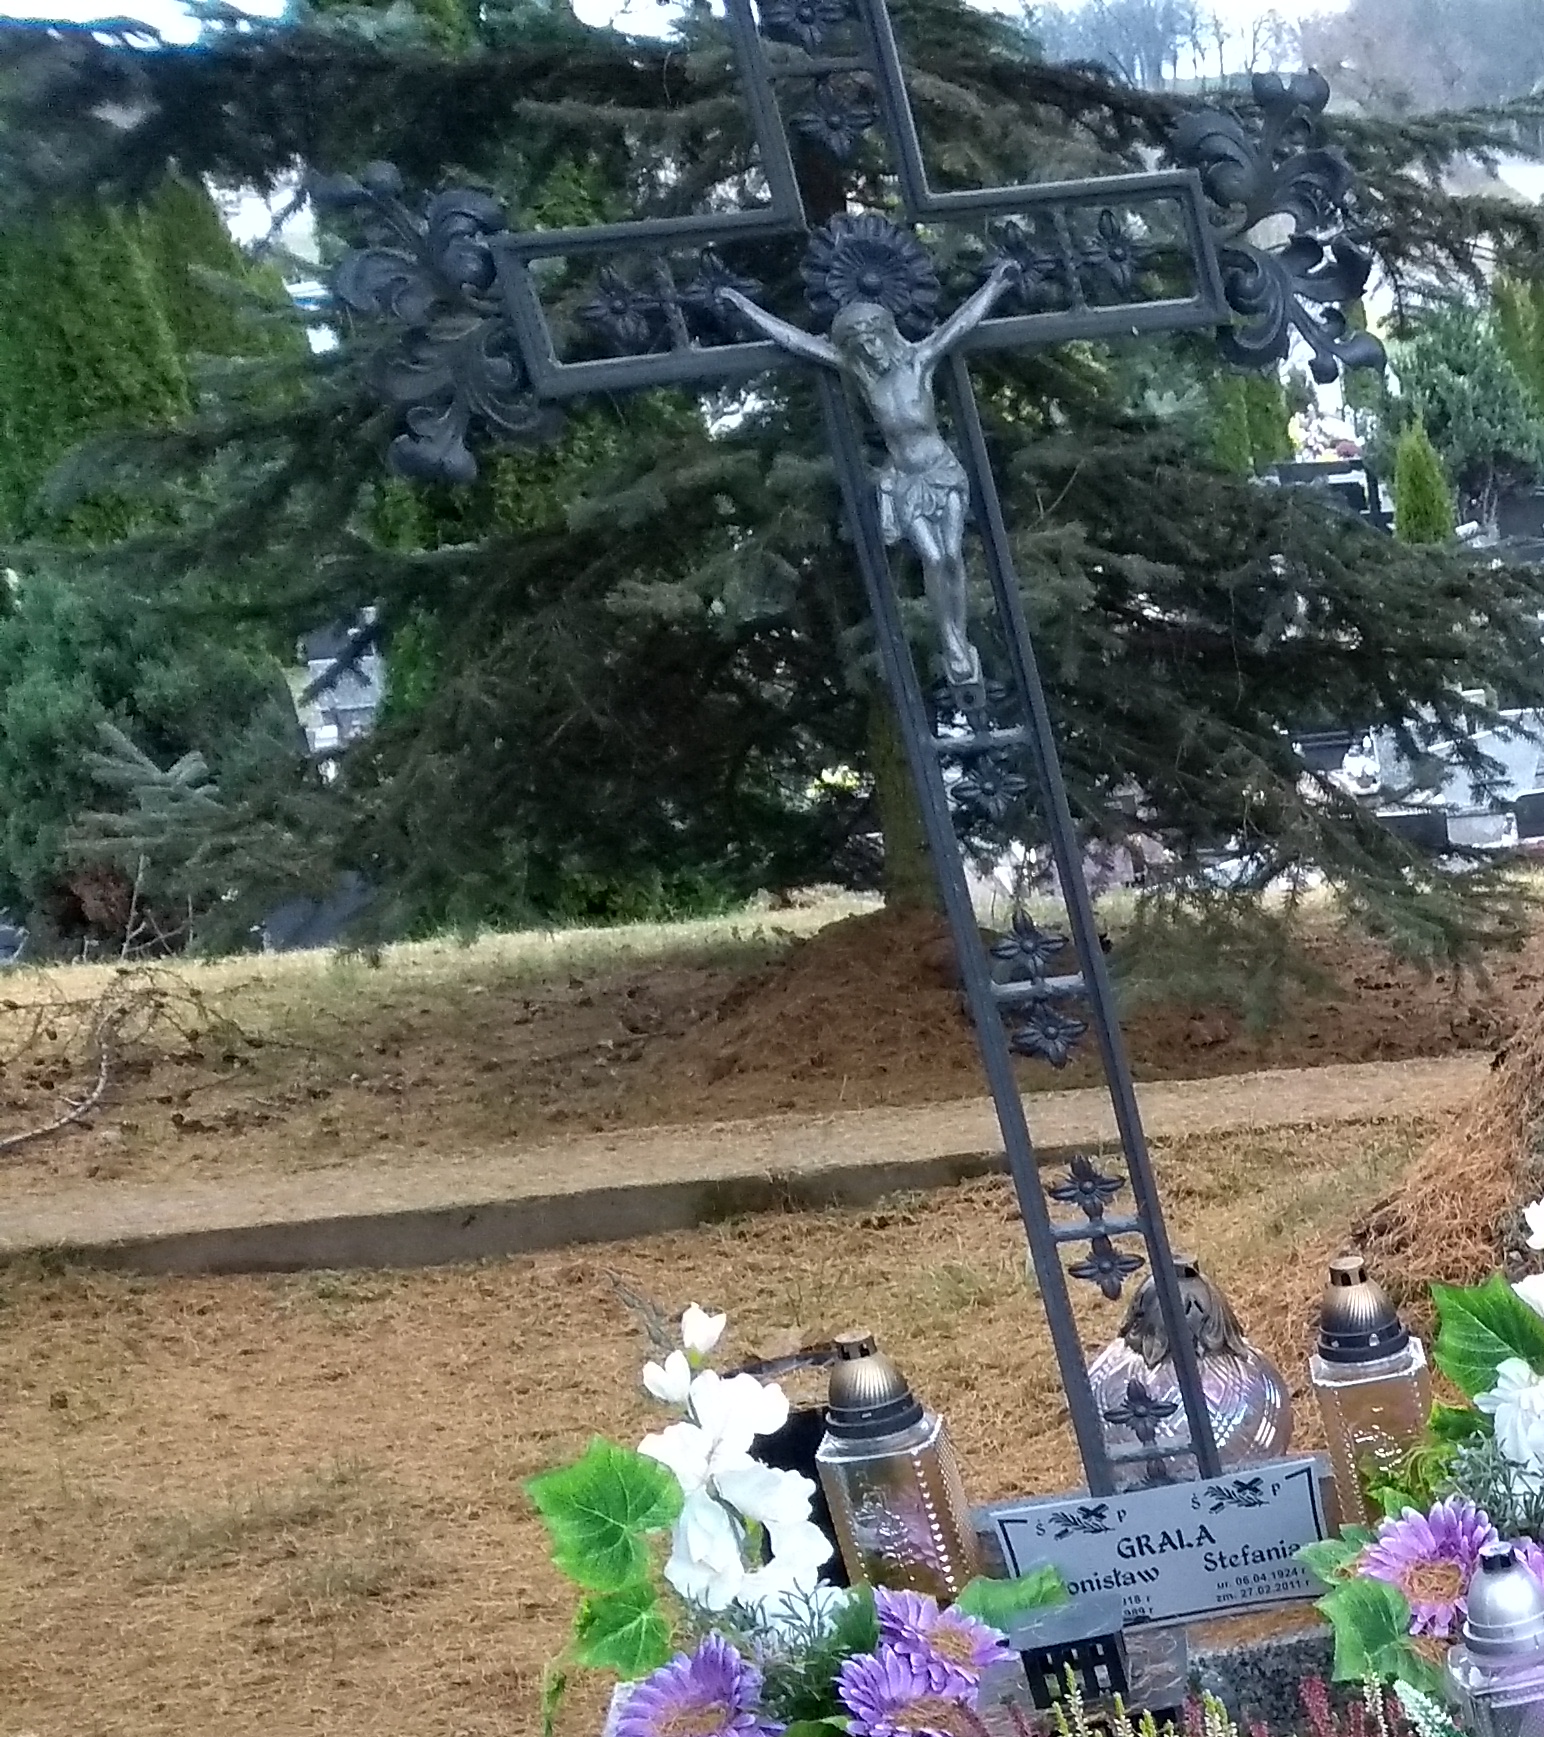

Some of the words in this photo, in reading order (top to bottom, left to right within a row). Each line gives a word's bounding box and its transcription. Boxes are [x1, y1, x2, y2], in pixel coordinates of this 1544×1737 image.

[1117, 1524, 1216, 1559] GRALA
[1203, 1539, 1301, 1572] Stefania
[1067, 1567, 1160, 1596] onisław
